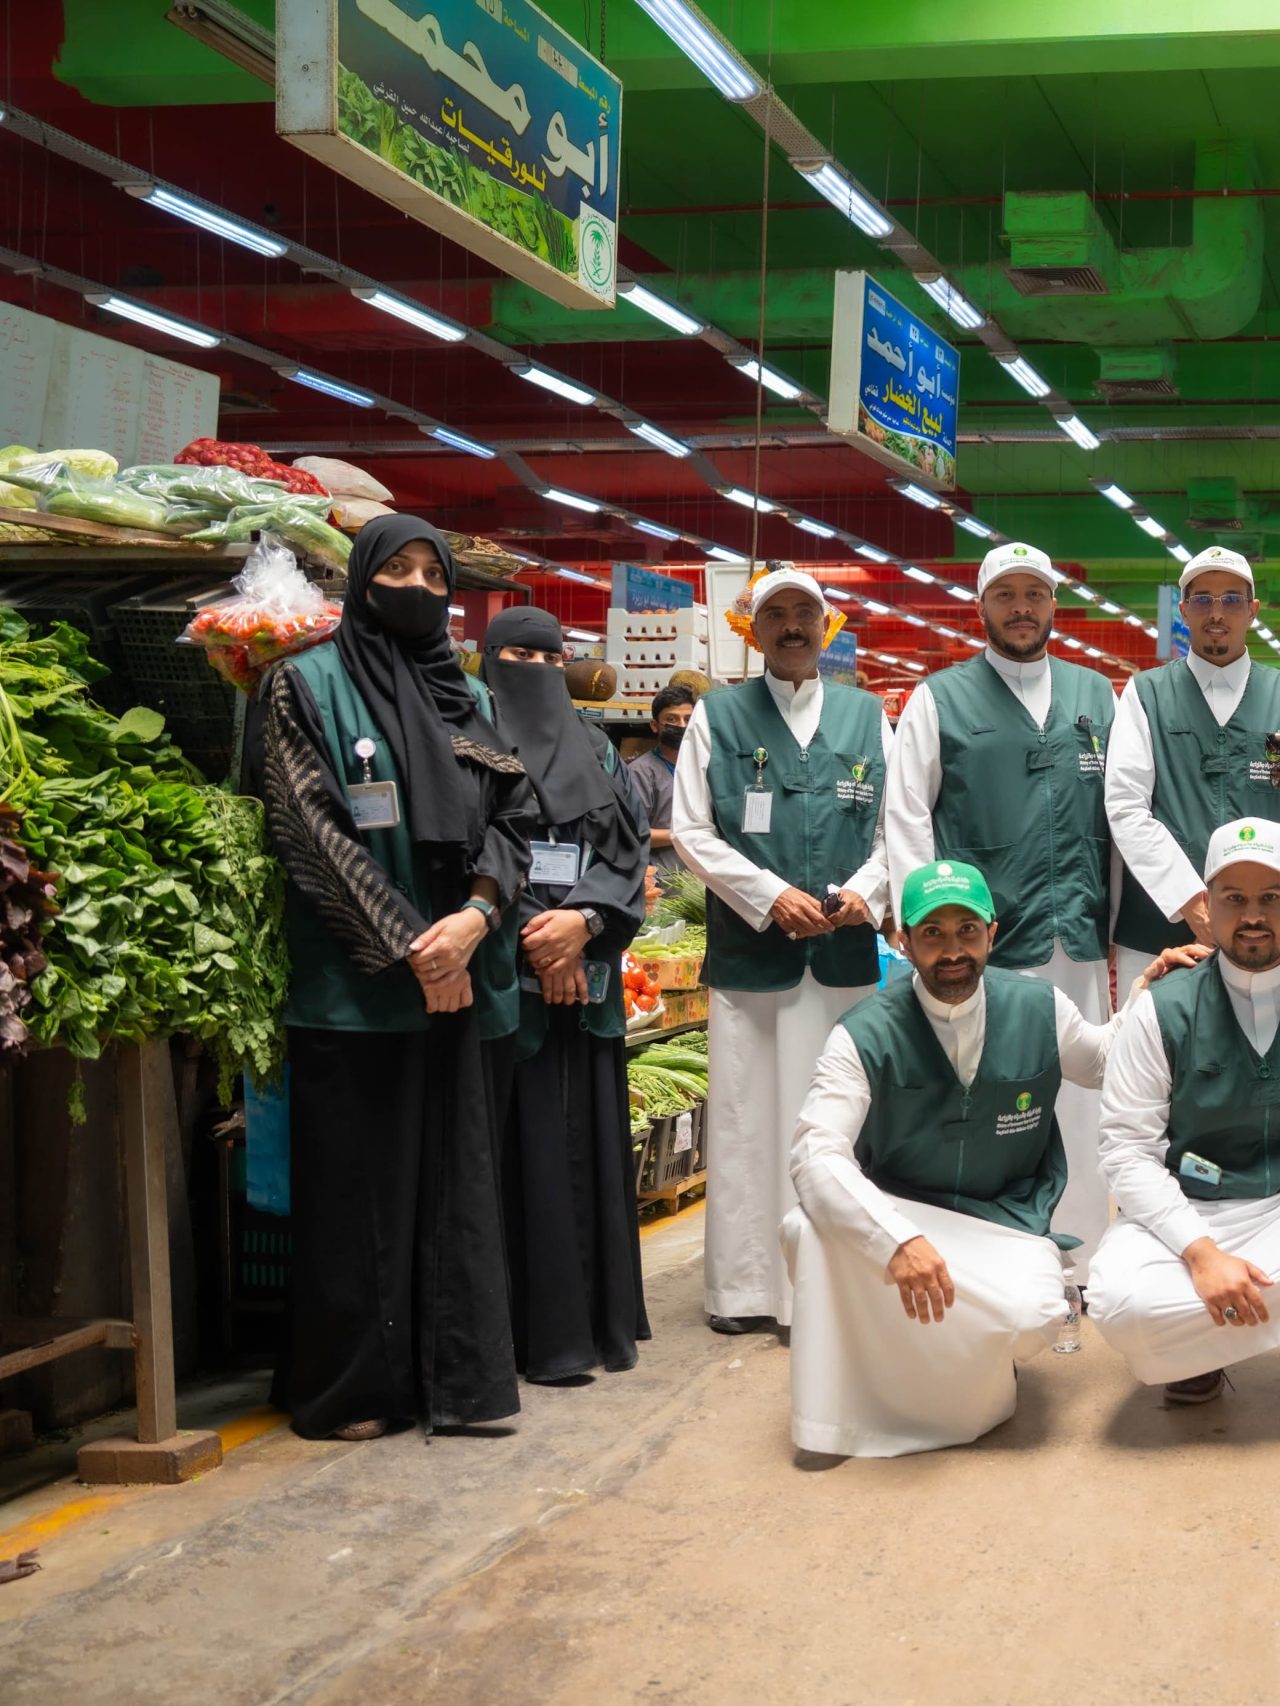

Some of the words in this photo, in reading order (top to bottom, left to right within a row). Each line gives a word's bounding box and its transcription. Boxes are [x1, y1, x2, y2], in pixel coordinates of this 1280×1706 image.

[373, 82, 399, 104] القرشي
[401, 99, 417, 115] حسين
[441, 97, 546, 192] للورقيات
[540, 111, 608, 199] أبو
[867, 327, 913, 378] أحمد
[882, 376, 921, 418] الخضار
[916, 363, 941, 400] أبو
[921, 406, 943, 438] لبيع
